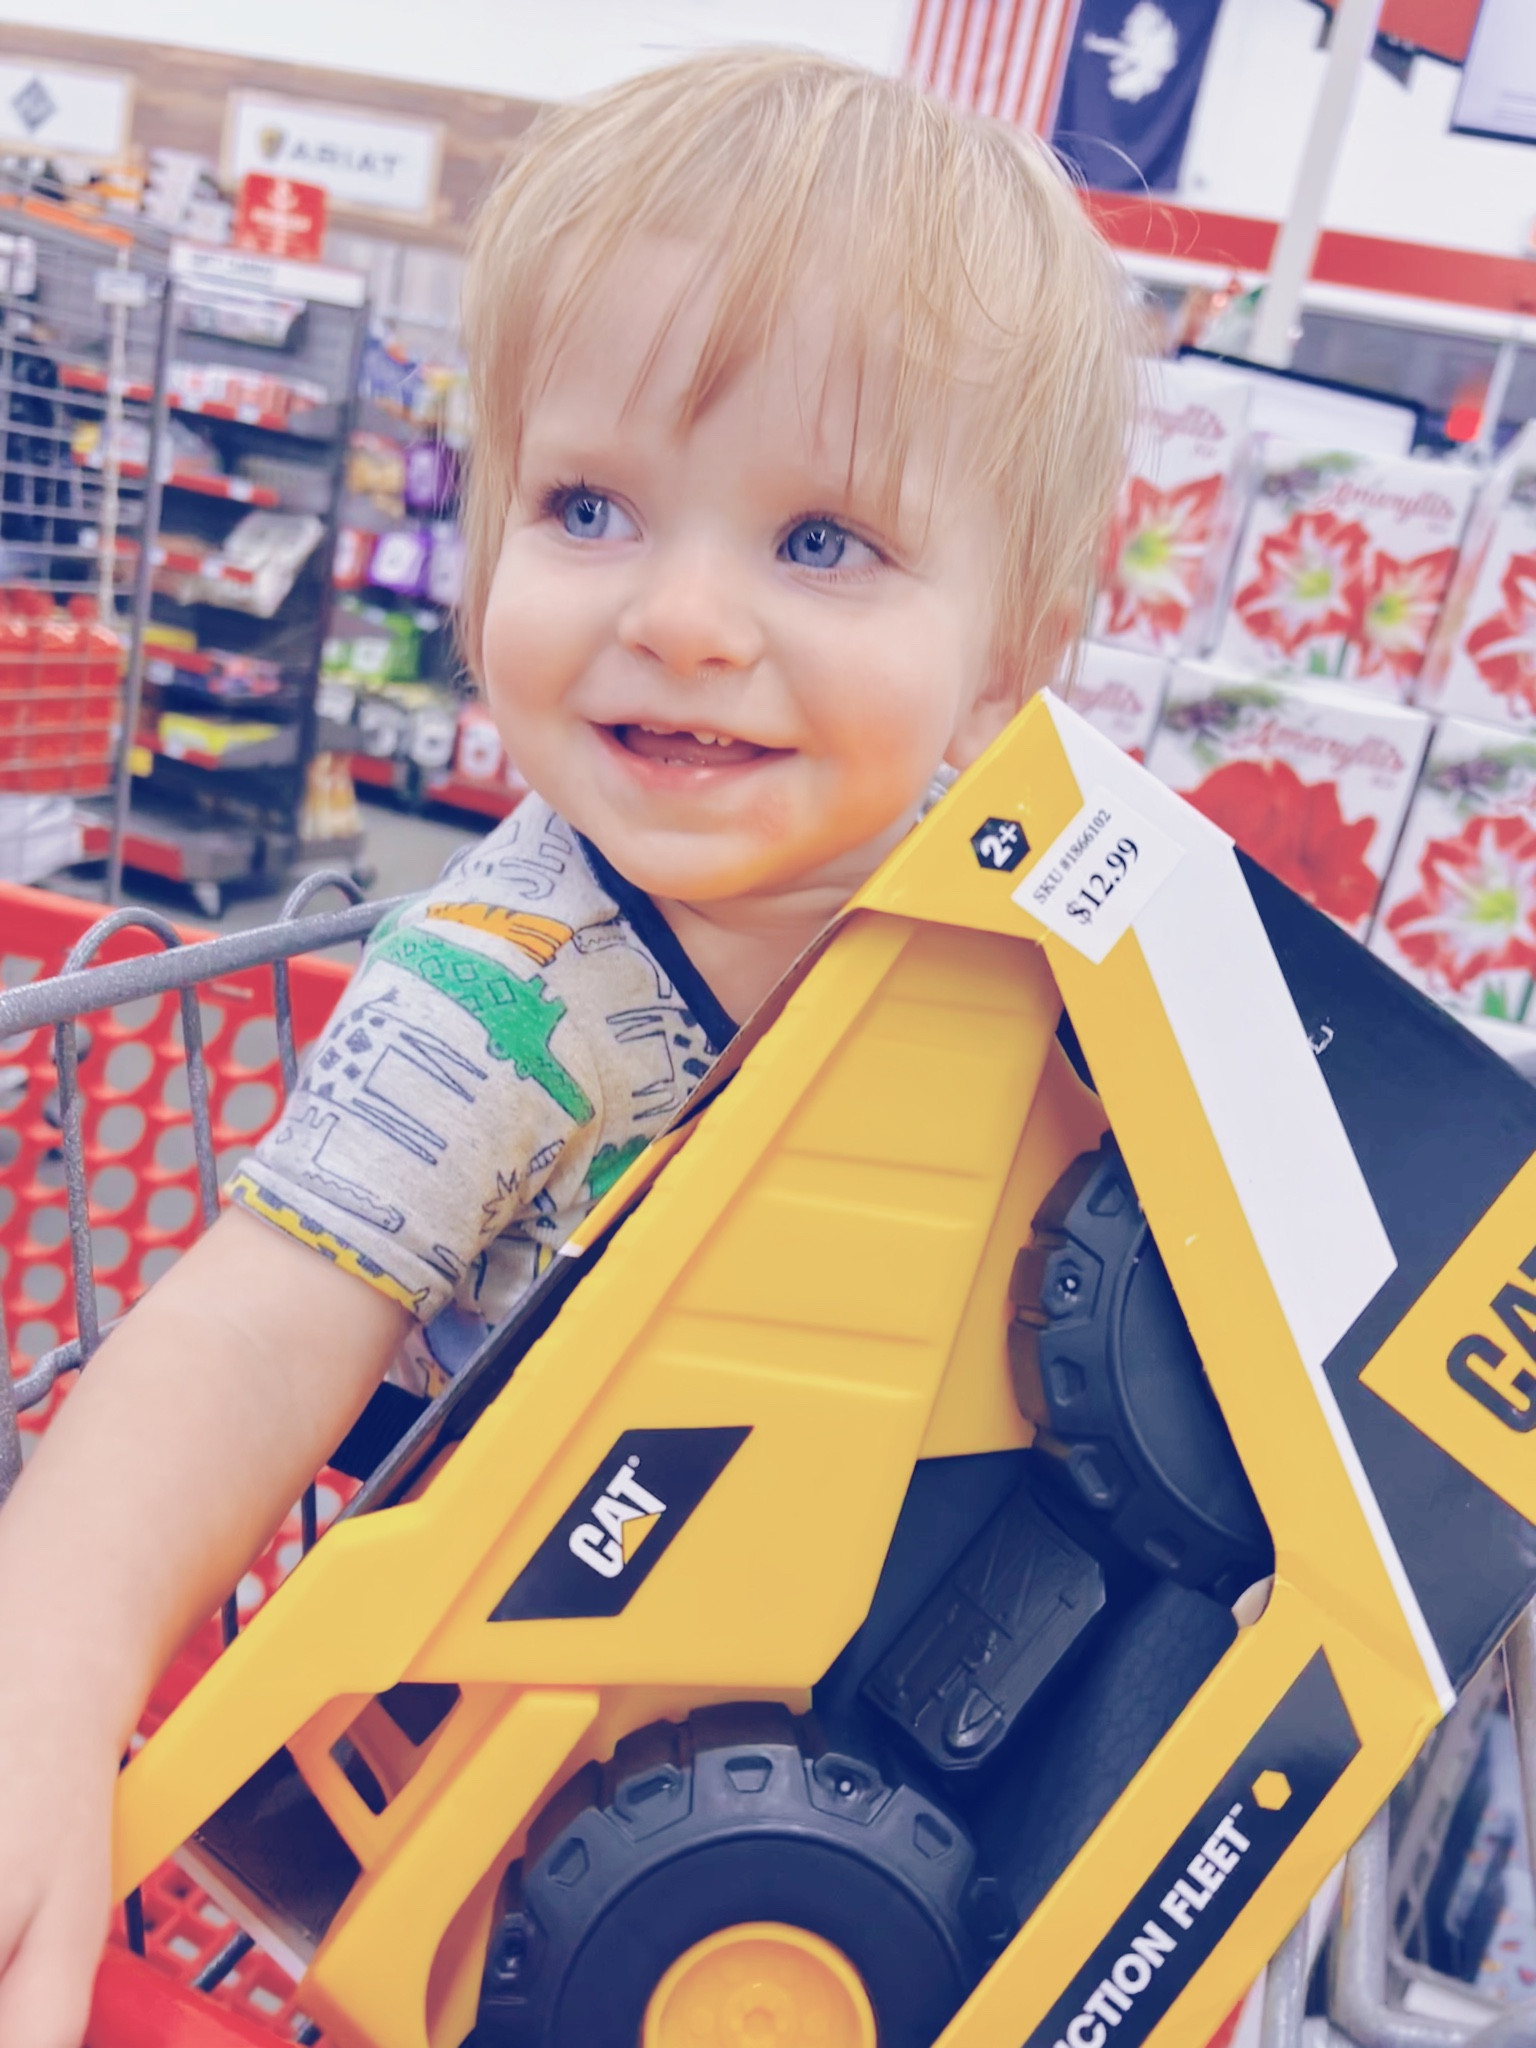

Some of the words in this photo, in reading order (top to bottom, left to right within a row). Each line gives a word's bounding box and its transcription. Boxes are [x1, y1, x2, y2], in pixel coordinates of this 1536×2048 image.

[980, 823, 1018, 868] 2+
[1033, 868, 1063, 904] SKU
[1060, 809, 1111, 871] #1866102
[1066, 838, 1139, 922] $12.99
[569, 1462, 667, 1578] CAT
[1052, 1920, 1178, 2048] CTION
[1159, 1812, 1251, 1930] FLEET
